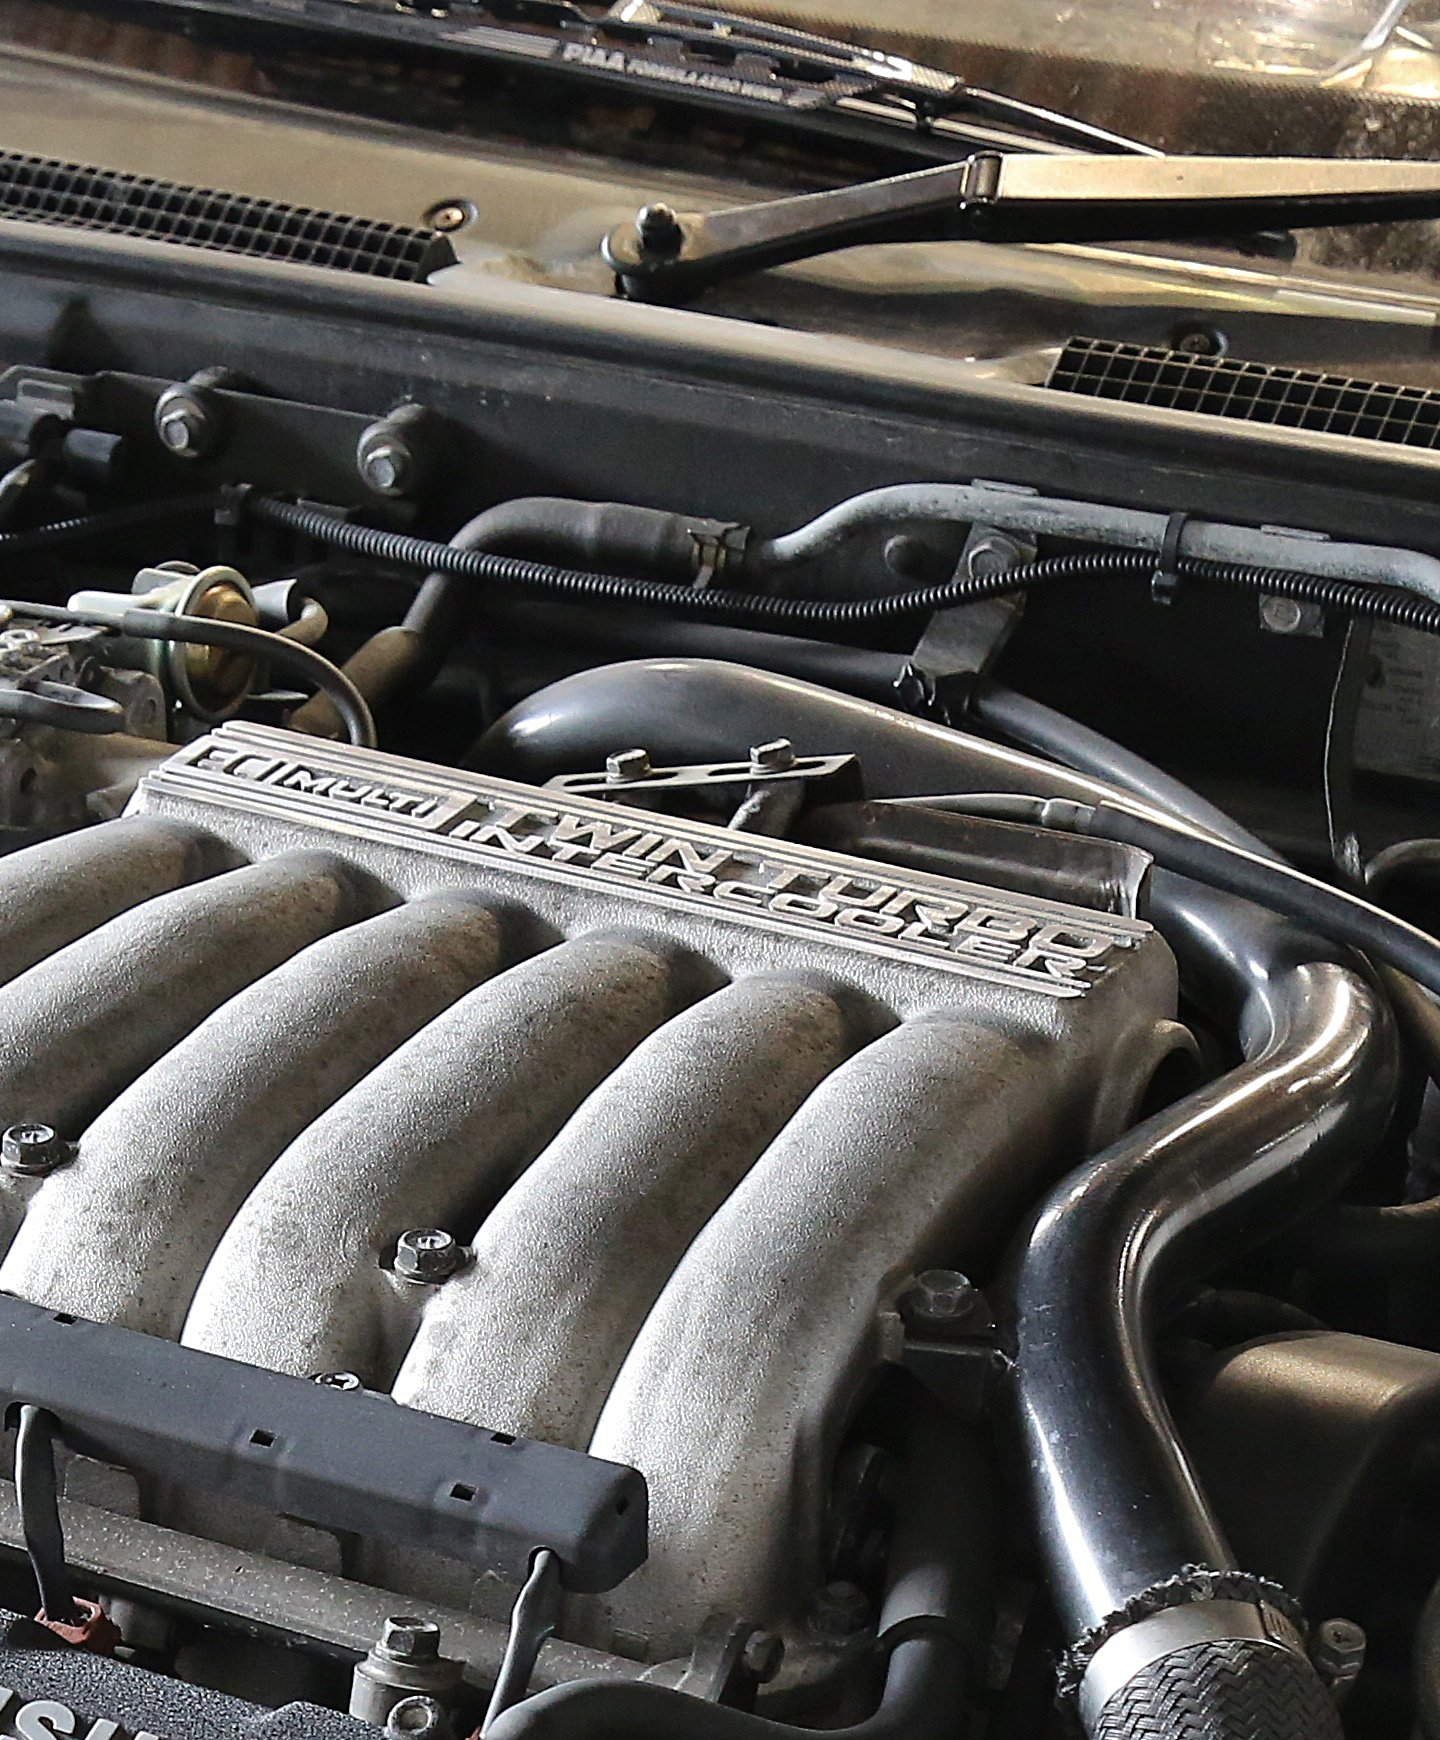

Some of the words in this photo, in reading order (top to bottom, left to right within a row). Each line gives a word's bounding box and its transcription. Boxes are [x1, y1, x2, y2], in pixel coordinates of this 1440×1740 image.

[562, 41, 626, 71] PIAA
[281, 766, 436, 820] MULTI
[449, 817, 1086, 981] INTERCOOLER
[489, 800, 739, 875] TWIN
[760, 859, 1117, 961] TURBO
